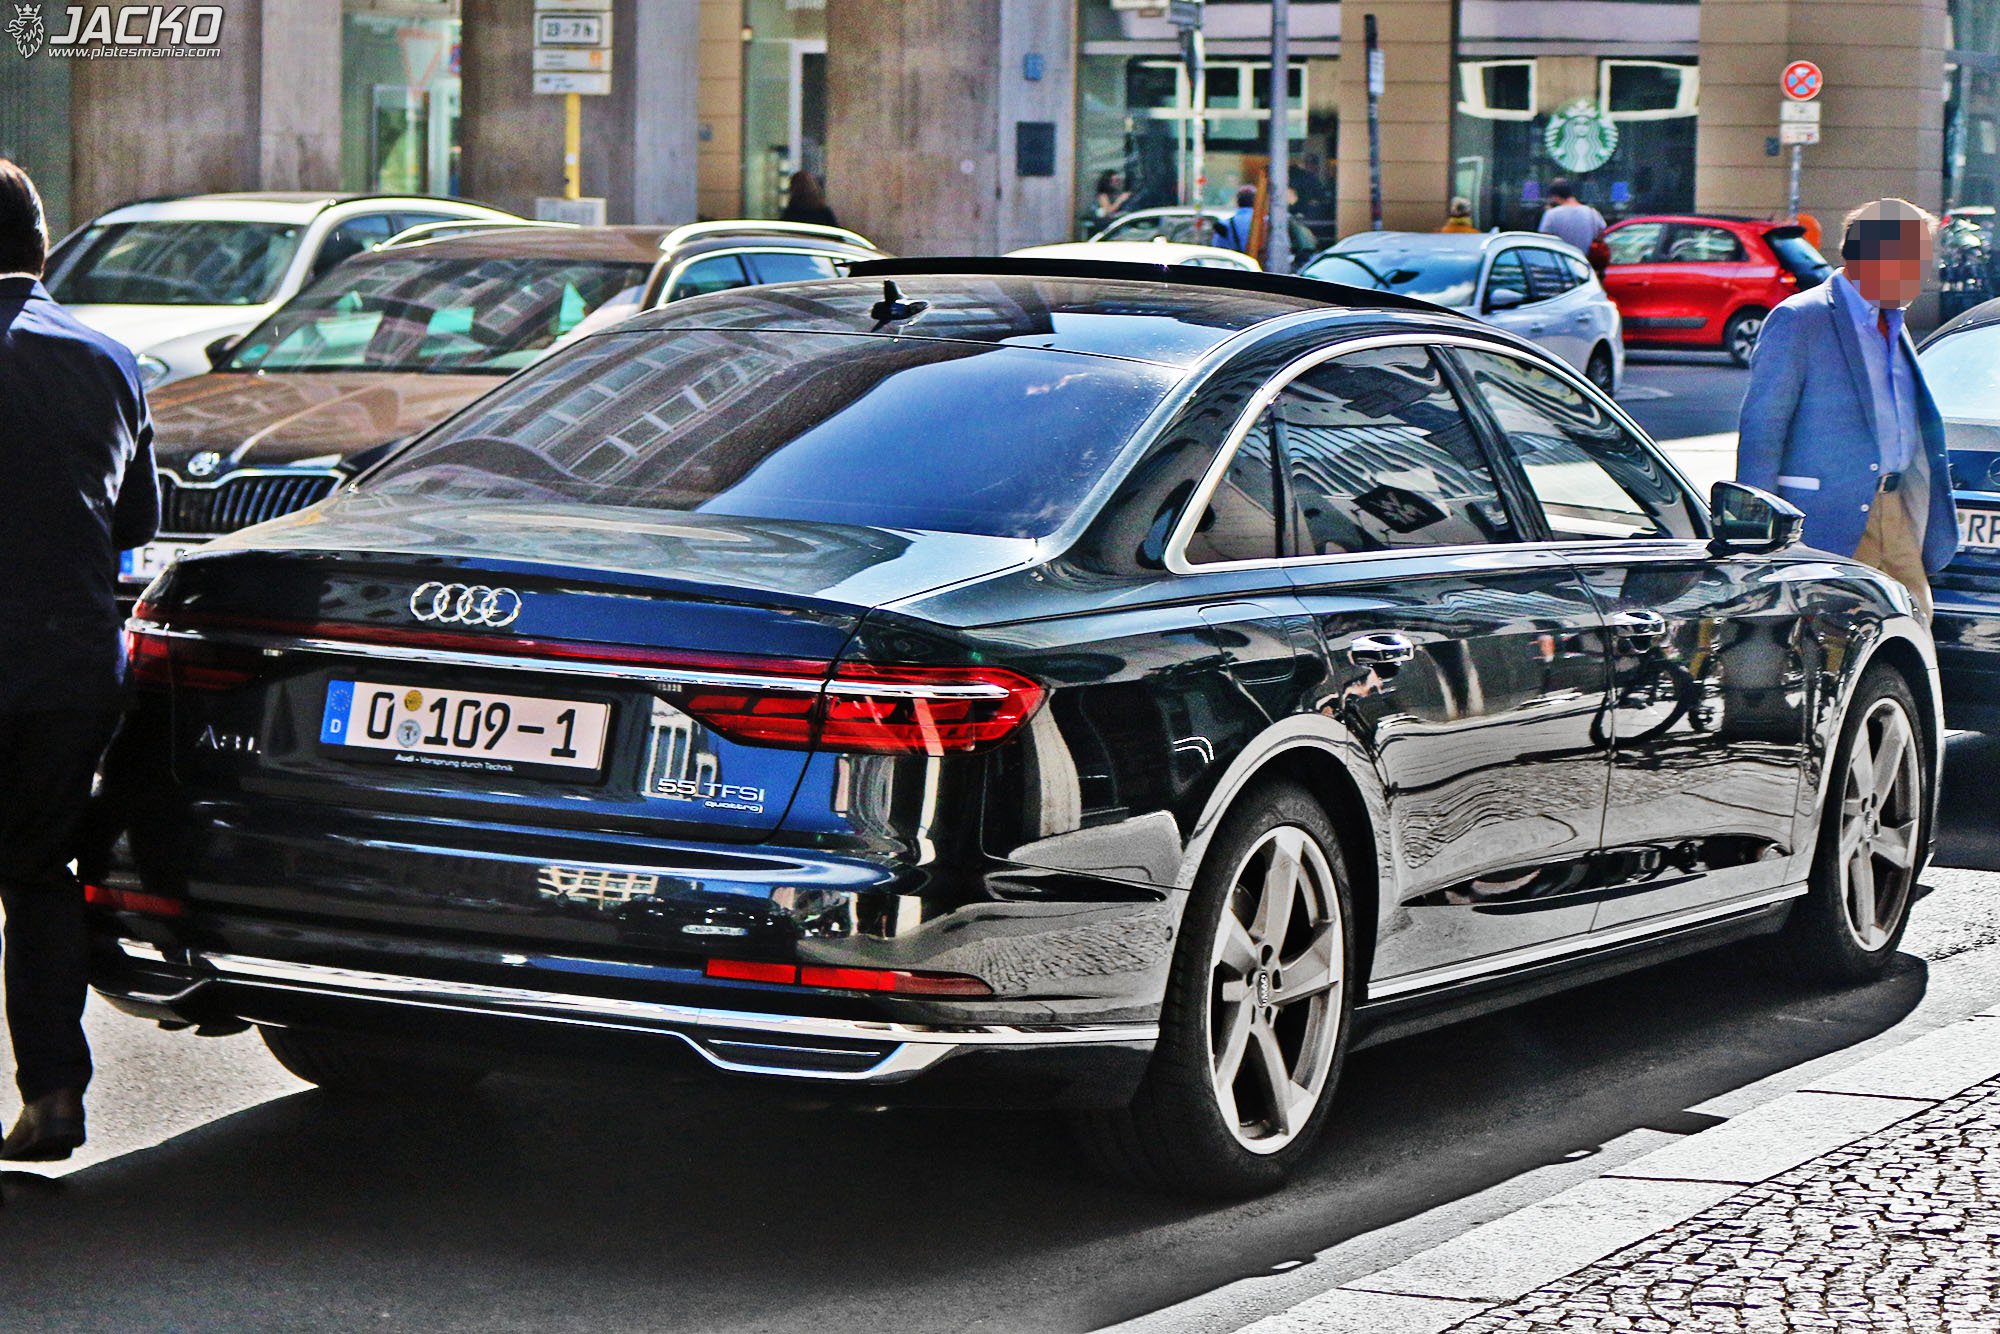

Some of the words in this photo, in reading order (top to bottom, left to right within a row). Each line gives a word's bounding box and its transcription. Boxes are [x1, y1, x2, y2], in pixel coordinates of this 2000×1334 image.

[329, 718, 342, 734] D
[423, 697, 578, 759] 109-1
[394, 754, 415, 763] Audi
[420, 756, 460, 768] Vorsprung
[461, 761, 483, 769] durch
[485, 762, 513, 772] Technik
[656, 777, 697, 796] 55
[704, 782, 766, 803] TFSI
[704, 800, 764, 814] quattro
